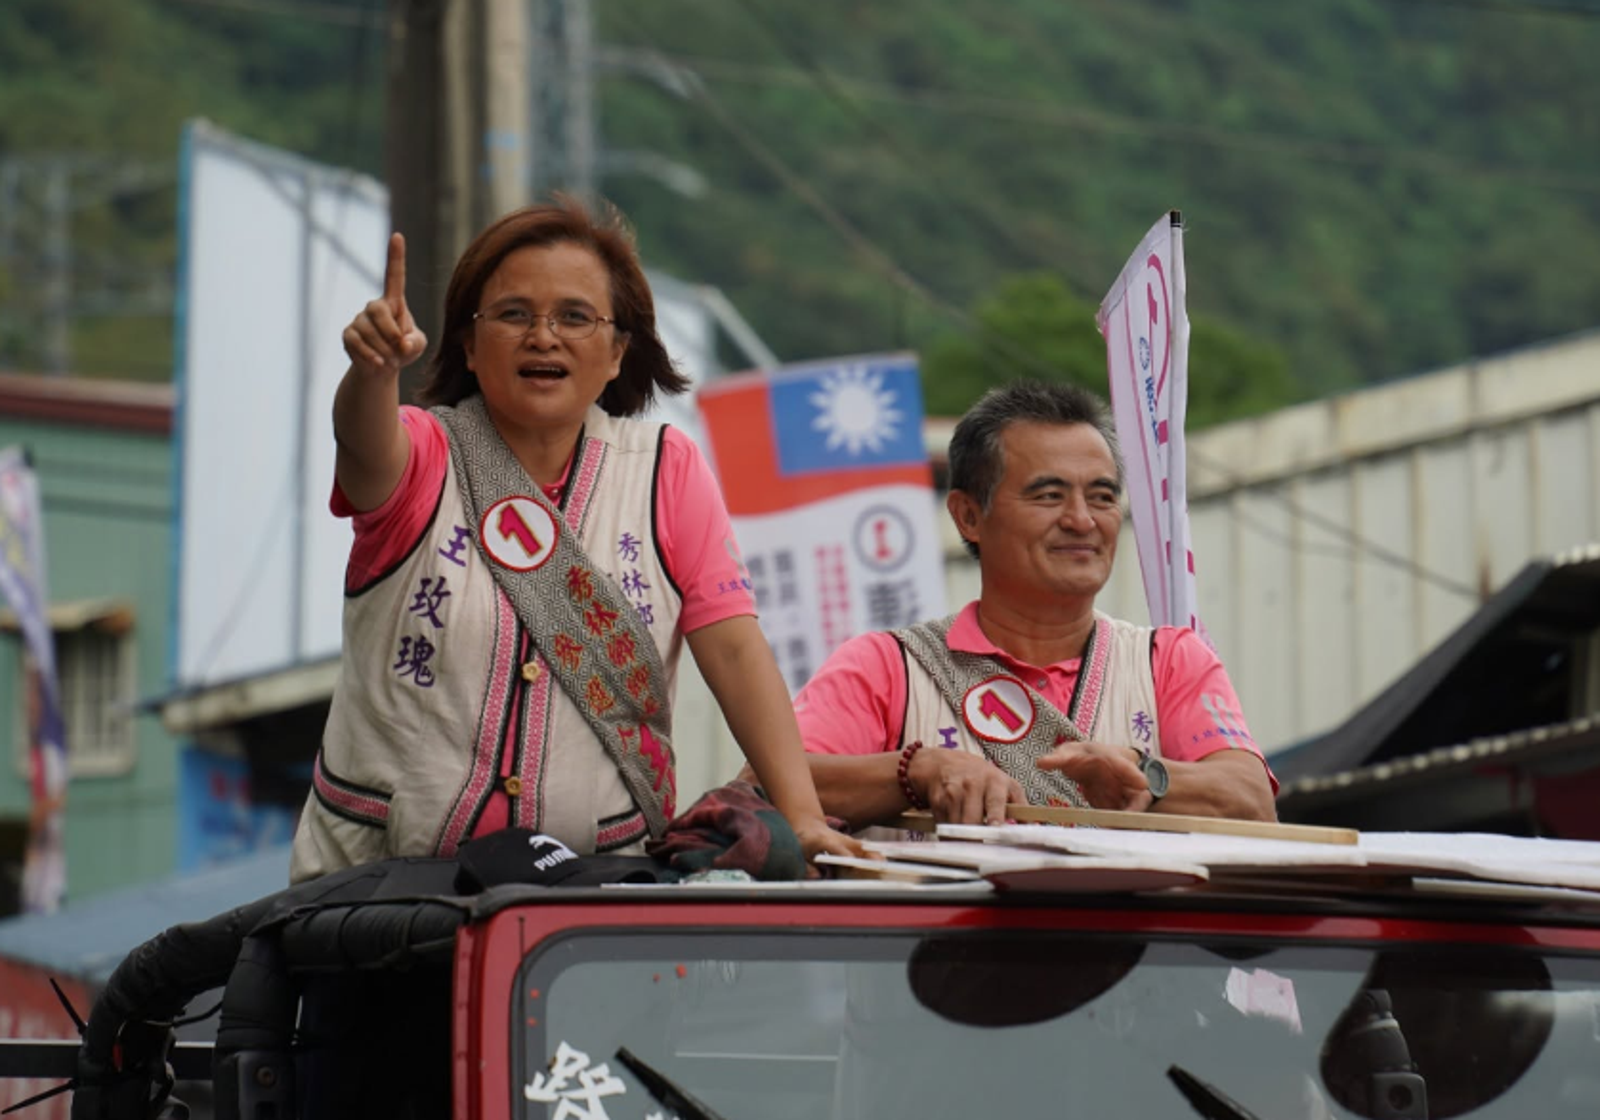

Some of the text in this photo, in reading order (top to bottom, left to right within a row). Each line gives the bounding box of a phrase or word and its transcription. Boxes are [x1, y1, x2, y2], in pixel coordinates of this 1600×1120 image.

[497, 502, 544, 558] 1
[393, 524, 472, 688] 王玫瑰
[978, 688, 1025, 735] 1
[1131, 710, 1154, 755] 秀
[937, 726, 958, 749] 王
